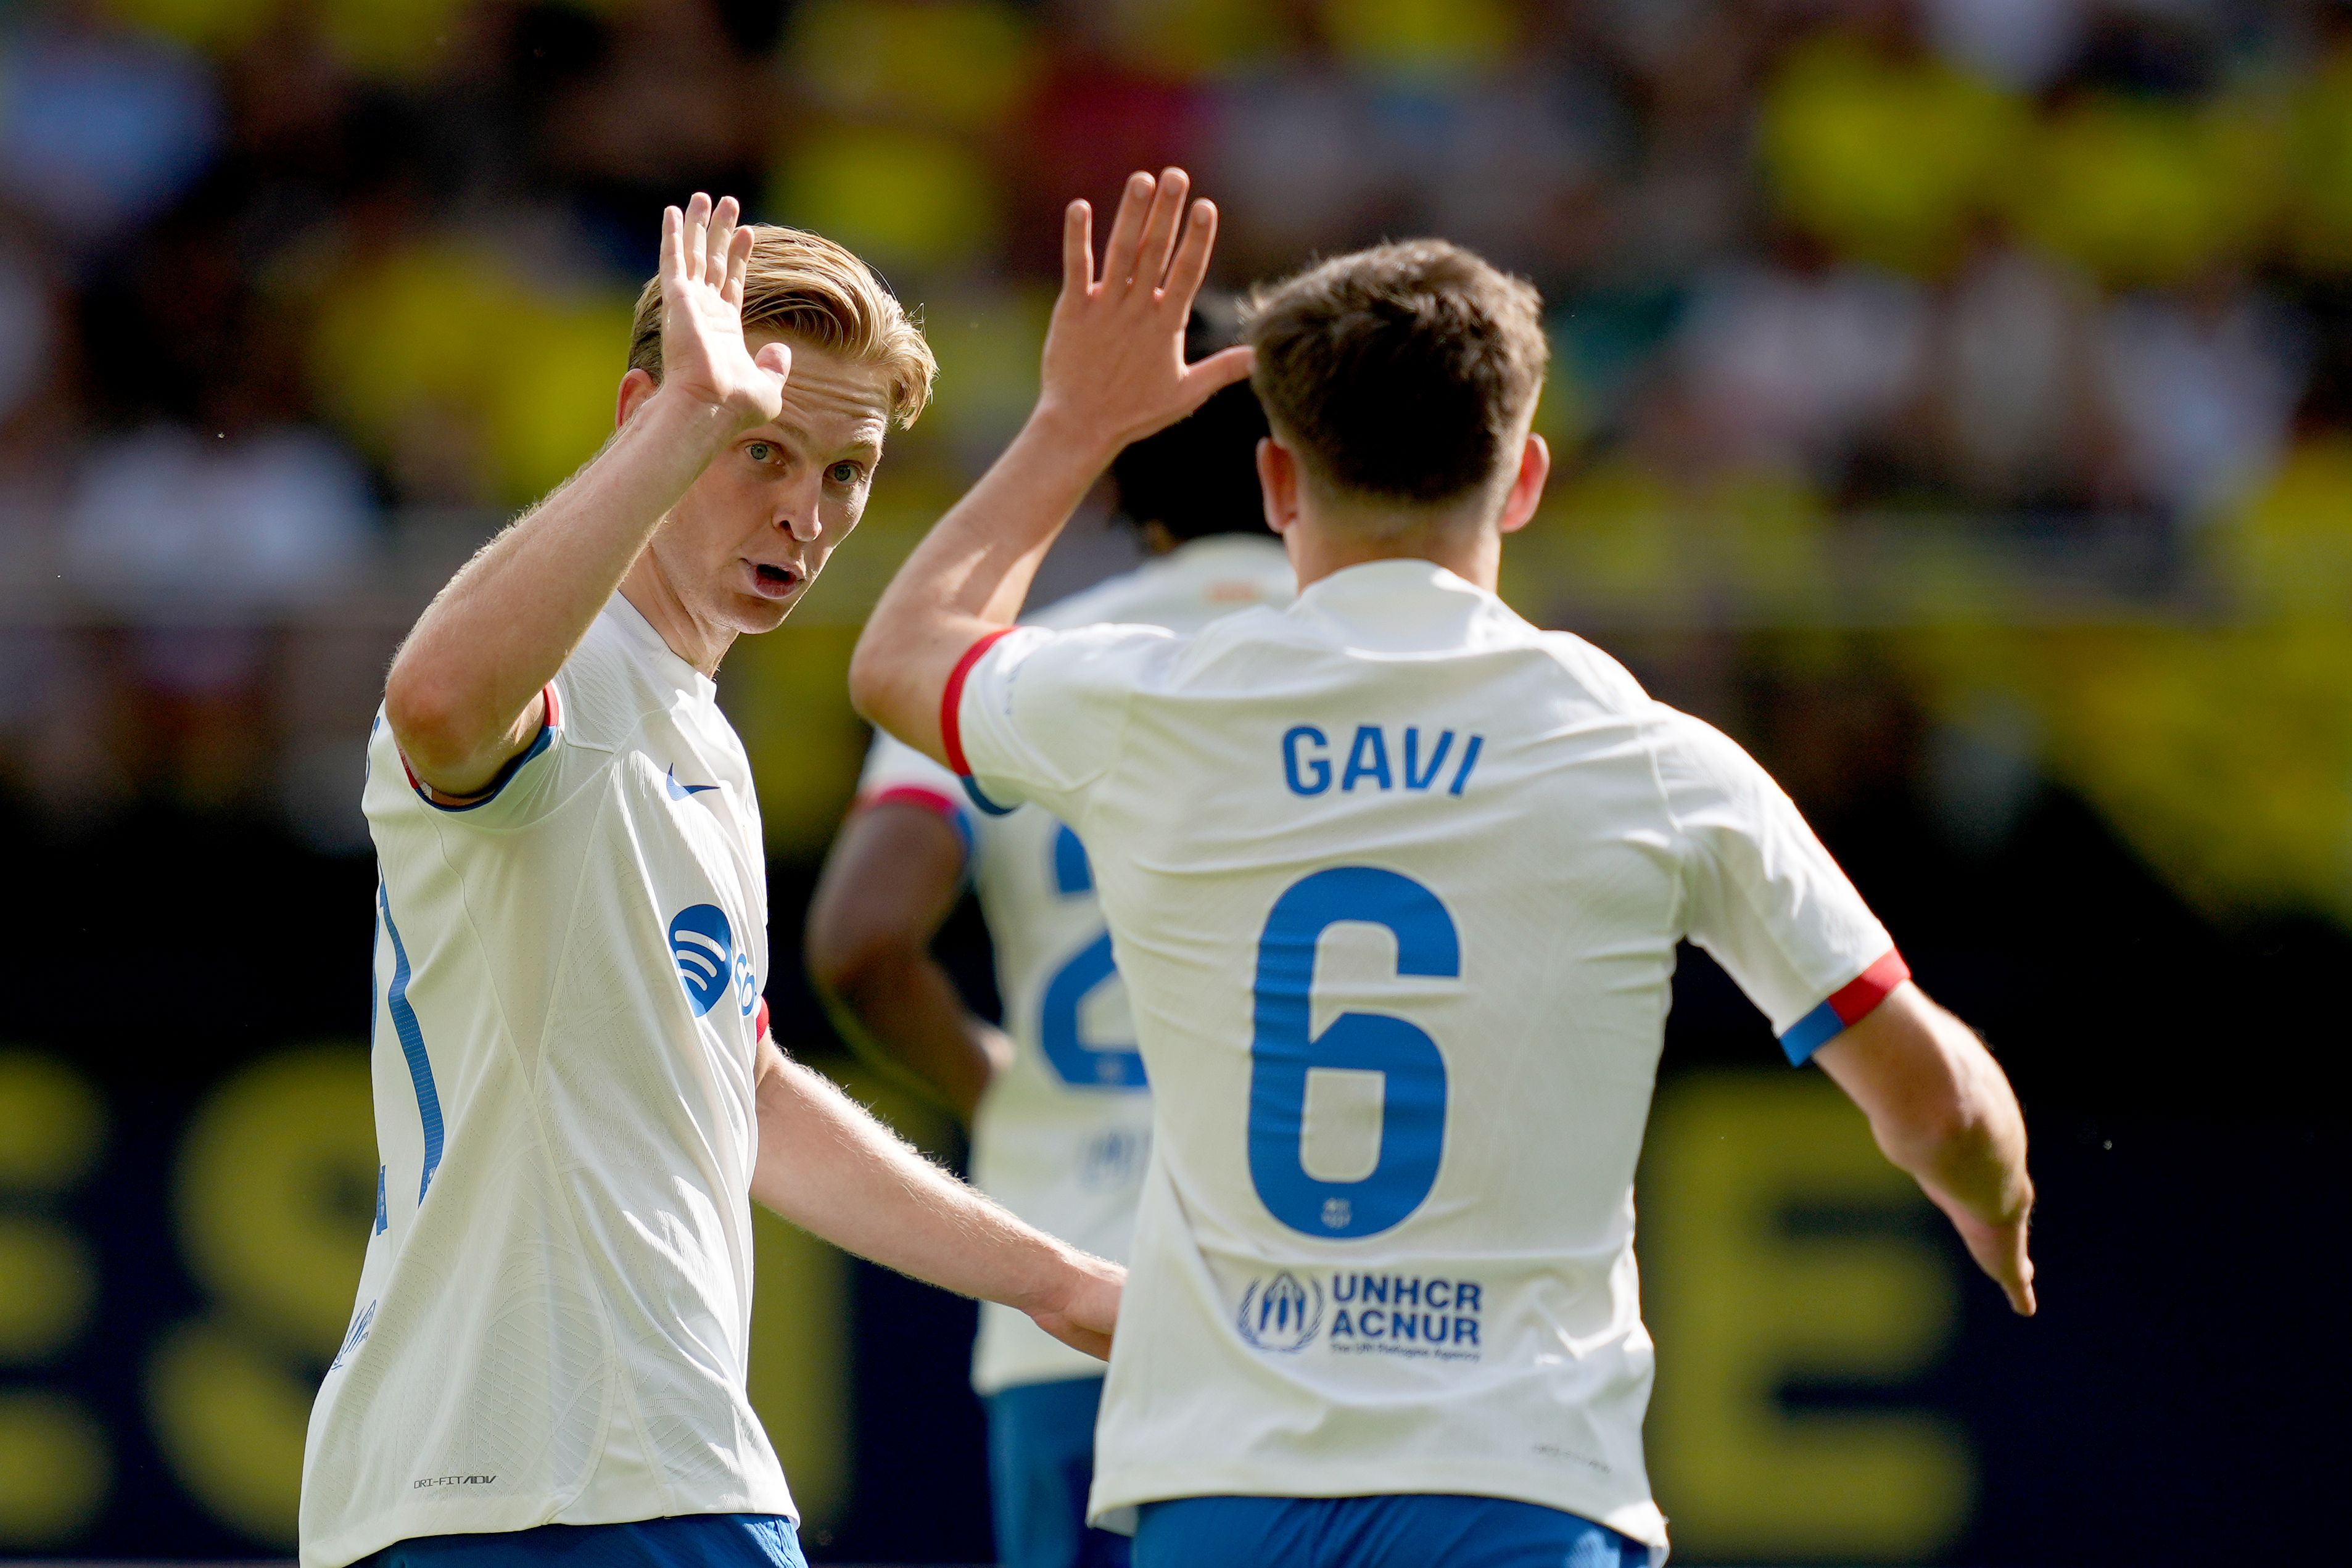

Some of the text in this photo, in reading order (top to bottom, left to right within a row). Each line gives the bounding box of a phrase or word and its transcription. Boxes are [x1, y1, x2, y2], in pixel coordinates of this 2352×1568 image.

[1282, 724, 1484, 796] GAVI
[1247, 865, 1460, 1239] 6
[1333, 1274, 1482, 1313] UNHCR
[1331, 1309, 1480, 1345] ACNUR
